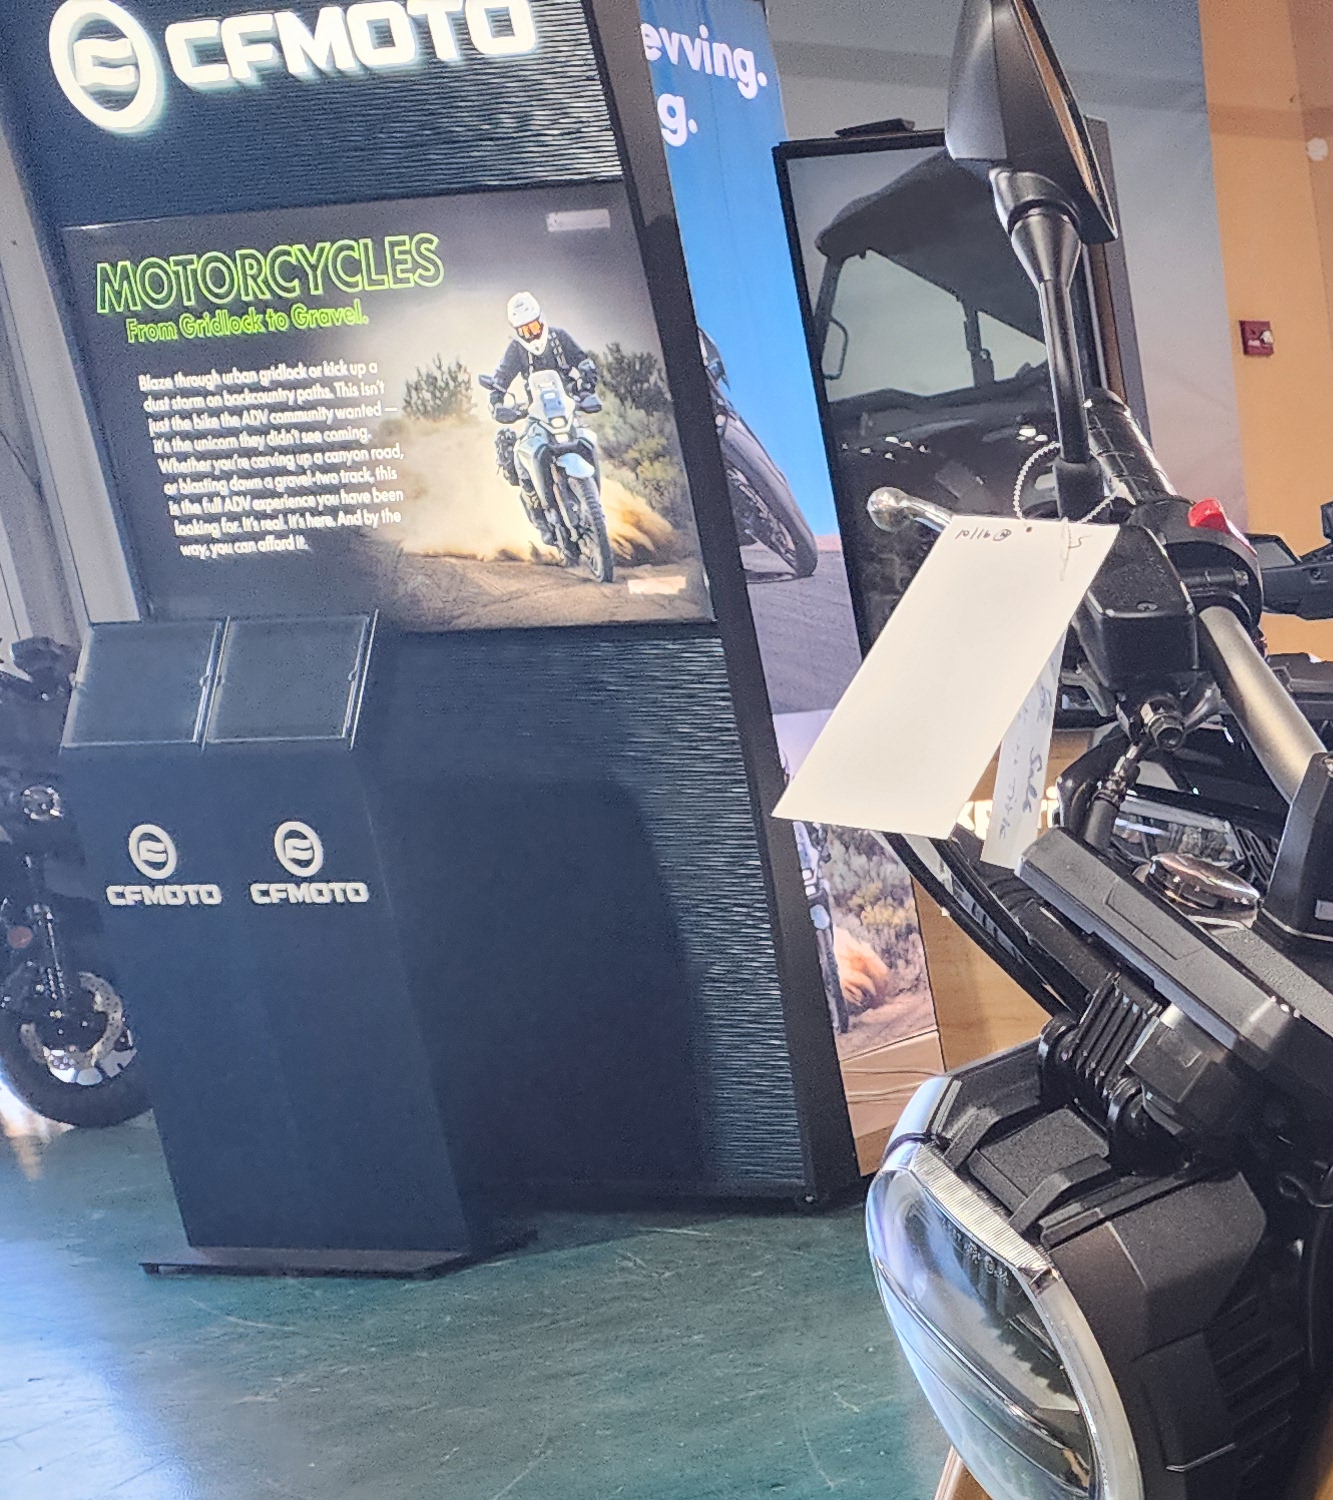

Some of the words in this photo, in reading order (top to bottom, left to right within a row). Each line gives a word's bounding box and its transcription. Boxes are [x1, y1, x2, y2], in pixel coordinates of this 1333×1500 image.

[165, 0, 536, 86] CFMOTO
[96, 232, 445, 313] MOTORCYCLES
[126, 316, 176, 343] From
[179, 307, 262, 339] Gridlock
[266, 309, 288, 330] to
[291, 298, 369, 328] Gravel.
[139, 374, 173, 391] Blaze
[174, 368, 221, 391] through
[222, 367, 257, 384] urban
[259, 362, 307, 386] gridlock
[309, 366, 322, 378] or
[323, 359, 348, 376] kick
[350, 363, 366, 379] up
[369, 362, 377, 373] a
[143, 395, 170, 412] dust
[171, 394, 204, 409] storm
[206, 395, 222, 407] on
[223, 386, 295, 405] backcountry
[334, 380, 359, 397] This
[359, 377, 384, 395] isn't
[149, 416, 170, 437] just
[172, 414, 192, 431] the
[193, 412, 219, 429] bike
[221, 410, 240, 427] the
[242, 408, 268, 426] ADV
[269, 405, 333, 425] community
[335, 400, 382, 419] wanted
[153, 436, 171, 453] it's
[172, 435, 192, 452] the
[194, 434, 238, 450] unicorn
[240, 431, 264, 451] they
[267, 428, 299, 446] didn't
[302, 432, 322, 443] see
[324, 425, 372, 445] coming.
[158, 455, 212, 473] Whether
[213, 452, 250, 475] you're
[251, 450, 295, 470] carving
[296, 453, 312, 469] up
[314, 452, 323, 463] a
[324, 449, 369, 466] canyon
[371, 442, 404, 461] road,
[169, 500, 180, 515] is
[181, 498, 202, 515] the
[203, 496, 222, 513] full
[224, 494, 251, 512] ADV
[252, 493, 316, 514] experience
[317, 494, 339, 511] you
[340, 488, 370, 504] have
[372, 486, 403, 502] been
[106, 884, 222, 905] CFMOTO
[250, 882, 369, 904] CFMOTO
